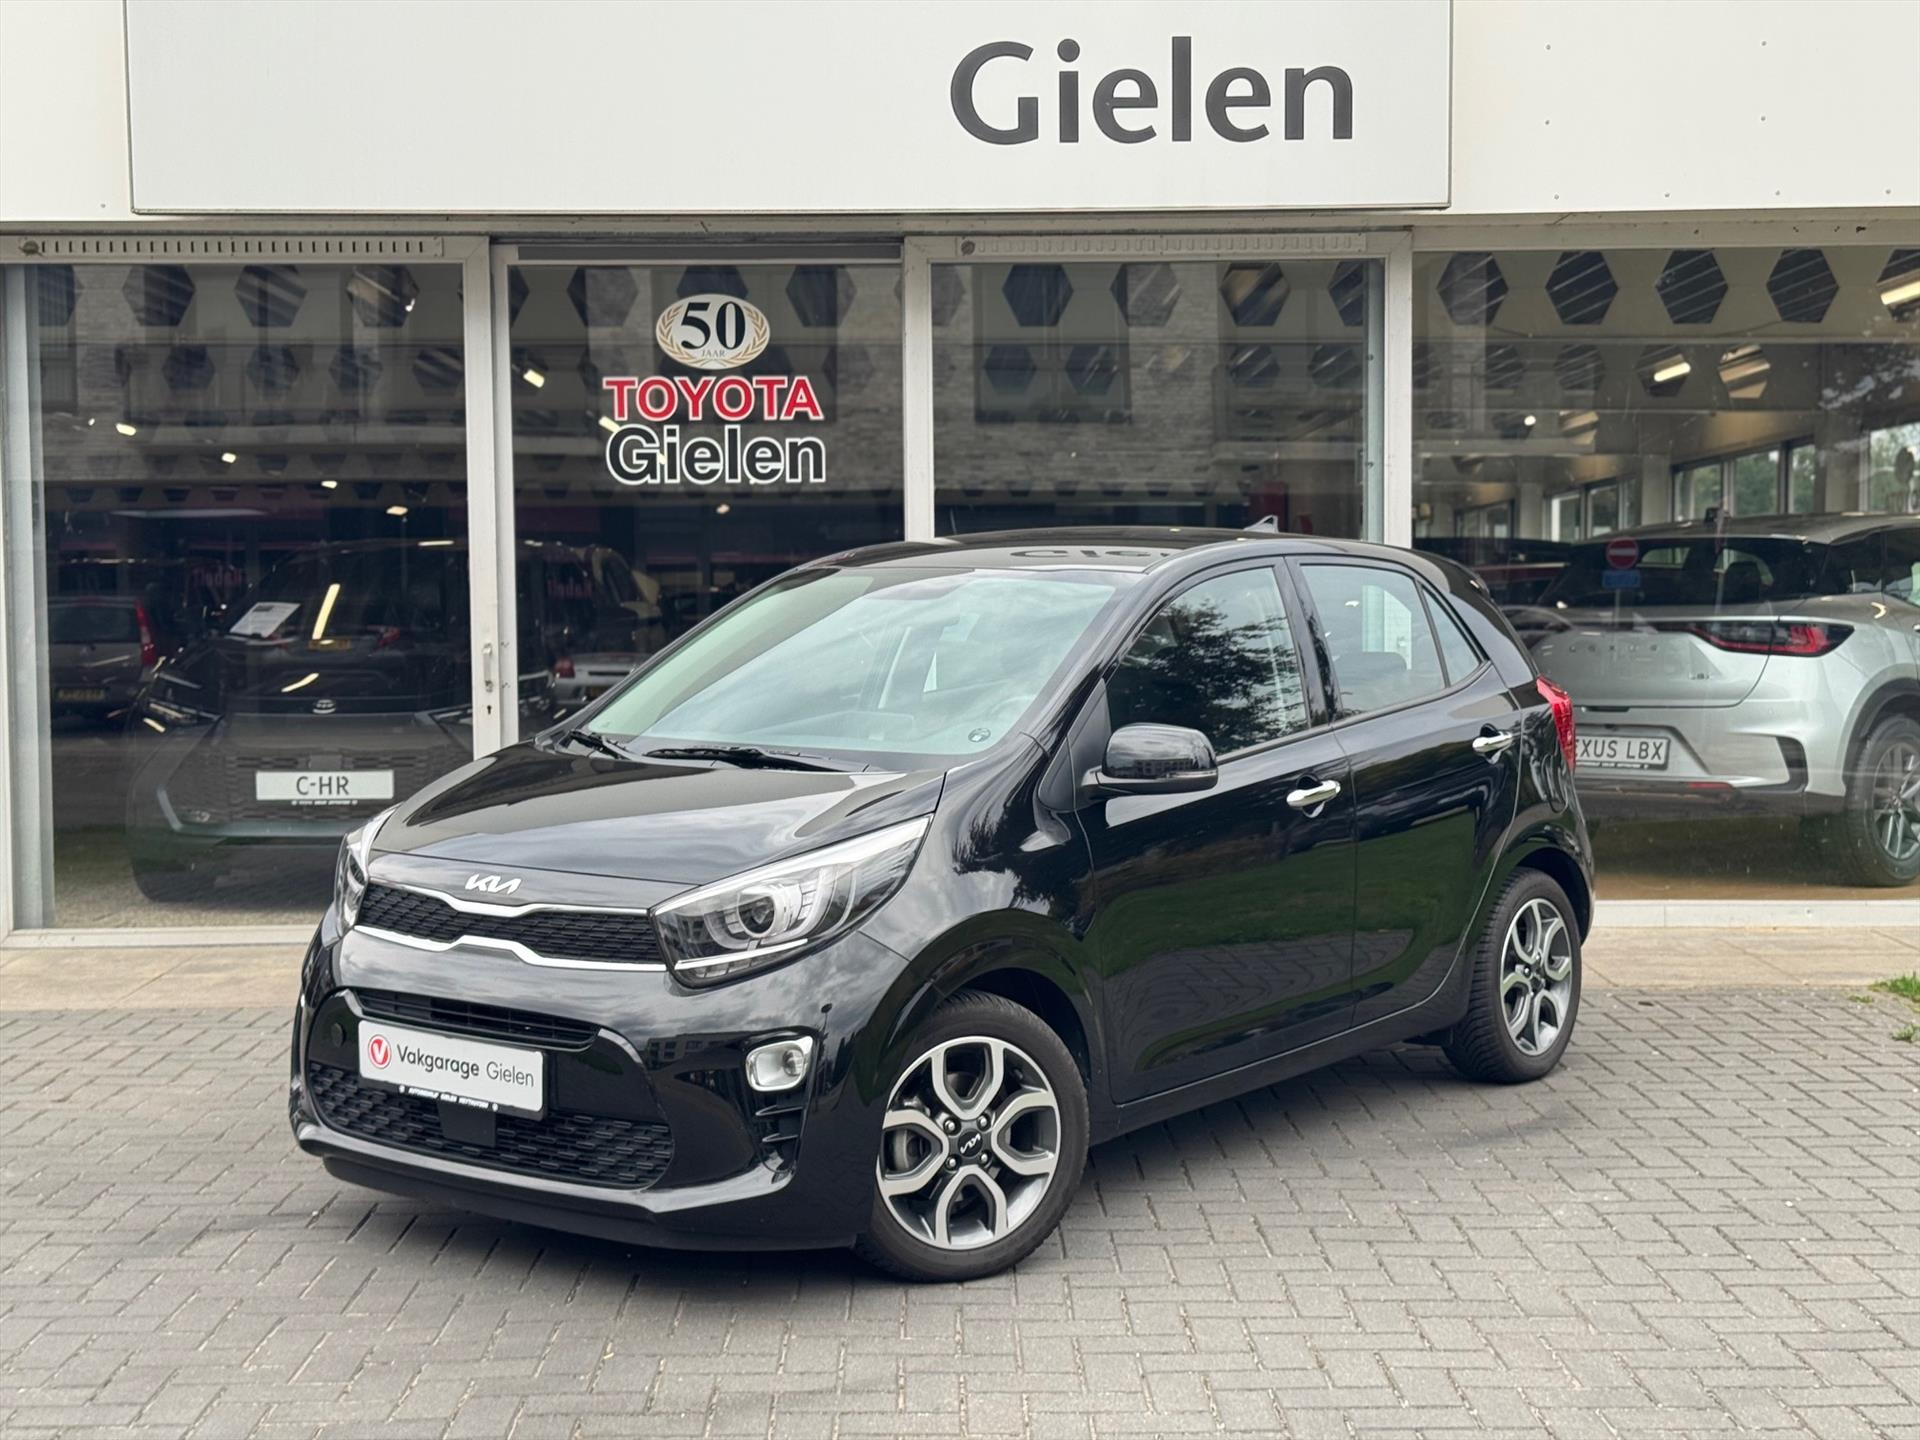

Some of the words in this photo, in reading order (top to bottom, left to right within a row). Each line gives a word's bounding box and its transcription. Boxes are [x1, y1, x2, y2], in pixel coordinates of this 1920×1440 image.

[949, 35, 1354, 145] Gielen
[680, 300, 746, 350] 50
[700, 349, 726, 358] JAAR
[602, 375, 825, 422] TOYOTA
[605, 423, 827, 486] Gielen
[1576, 738, 1618, 759] XUS
[1626, 740, 1663, 761] LBX
[295, 775, 350, 796] C-HR
[396, 1043, 480, 1079] Vakgarage
[486, 1060, 534, 1088] Gielen
